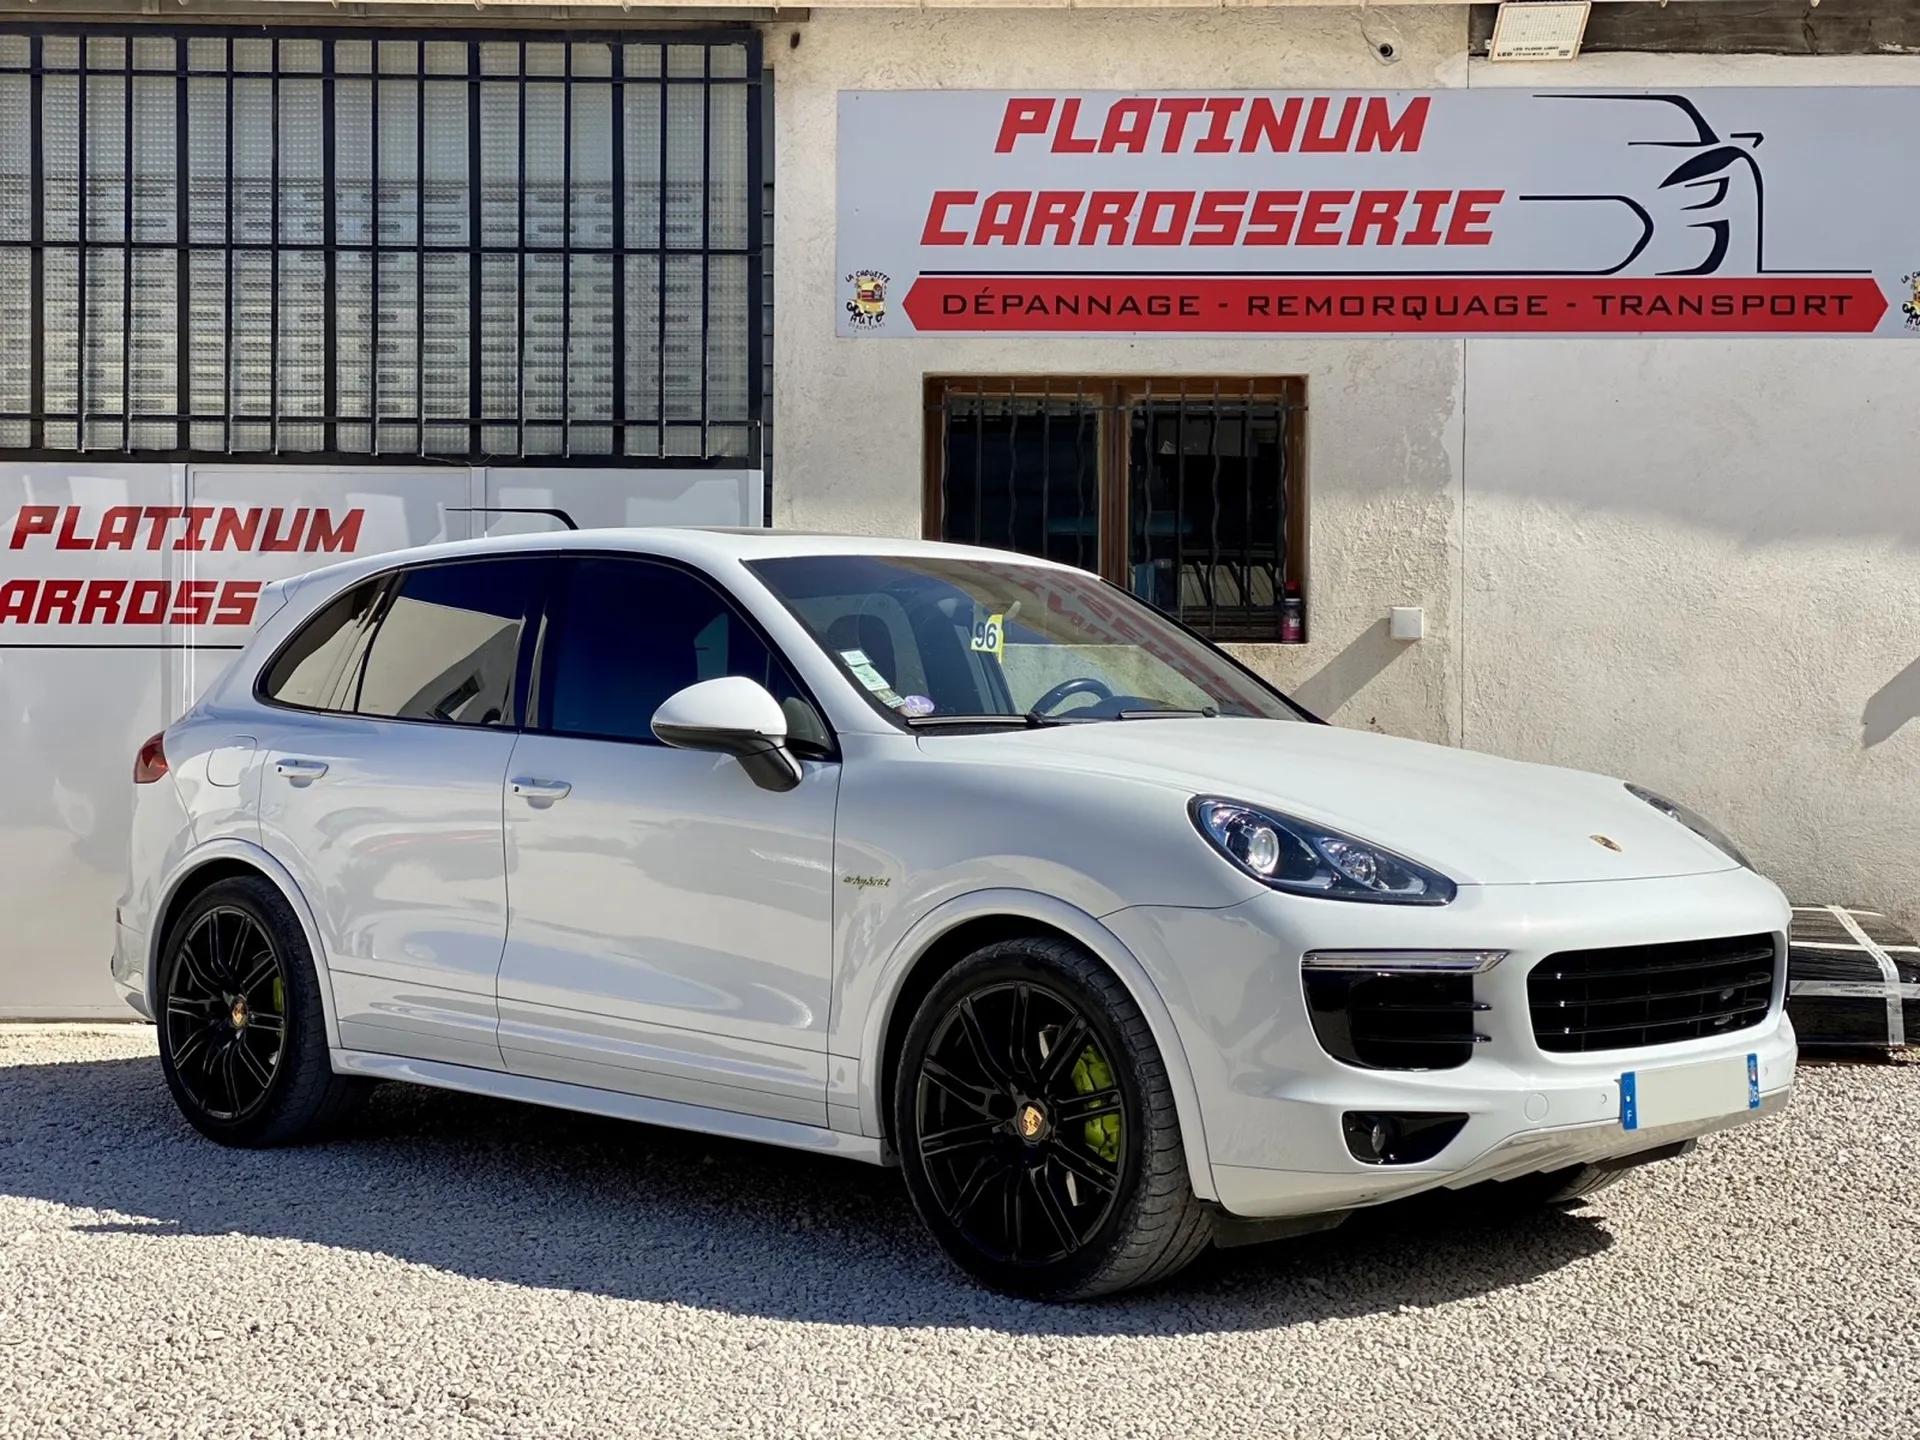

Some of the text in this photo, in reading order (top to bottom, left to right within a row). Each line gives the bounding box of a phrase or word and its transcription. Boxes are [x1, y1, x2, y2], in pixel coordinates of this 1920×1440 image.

[995, 96, 1431, 154] PLATINUM
[921, 189, 1505, 247] CARROSSERIE
[850, 313, 883, 326] AUTO
[942, 287, 1201, 316] DÉPANNAGE
[1247, 295, 1549, 321] REMORQUAGE
[1592, 294, 1854, 317] TRANSPORT
[9, 505, 365, 553] PLATINUM
[0, 579, 263, 626] ARROSS
[975, 621, 997, 650] 96
[1626, 1109, 1632, 1121] F
